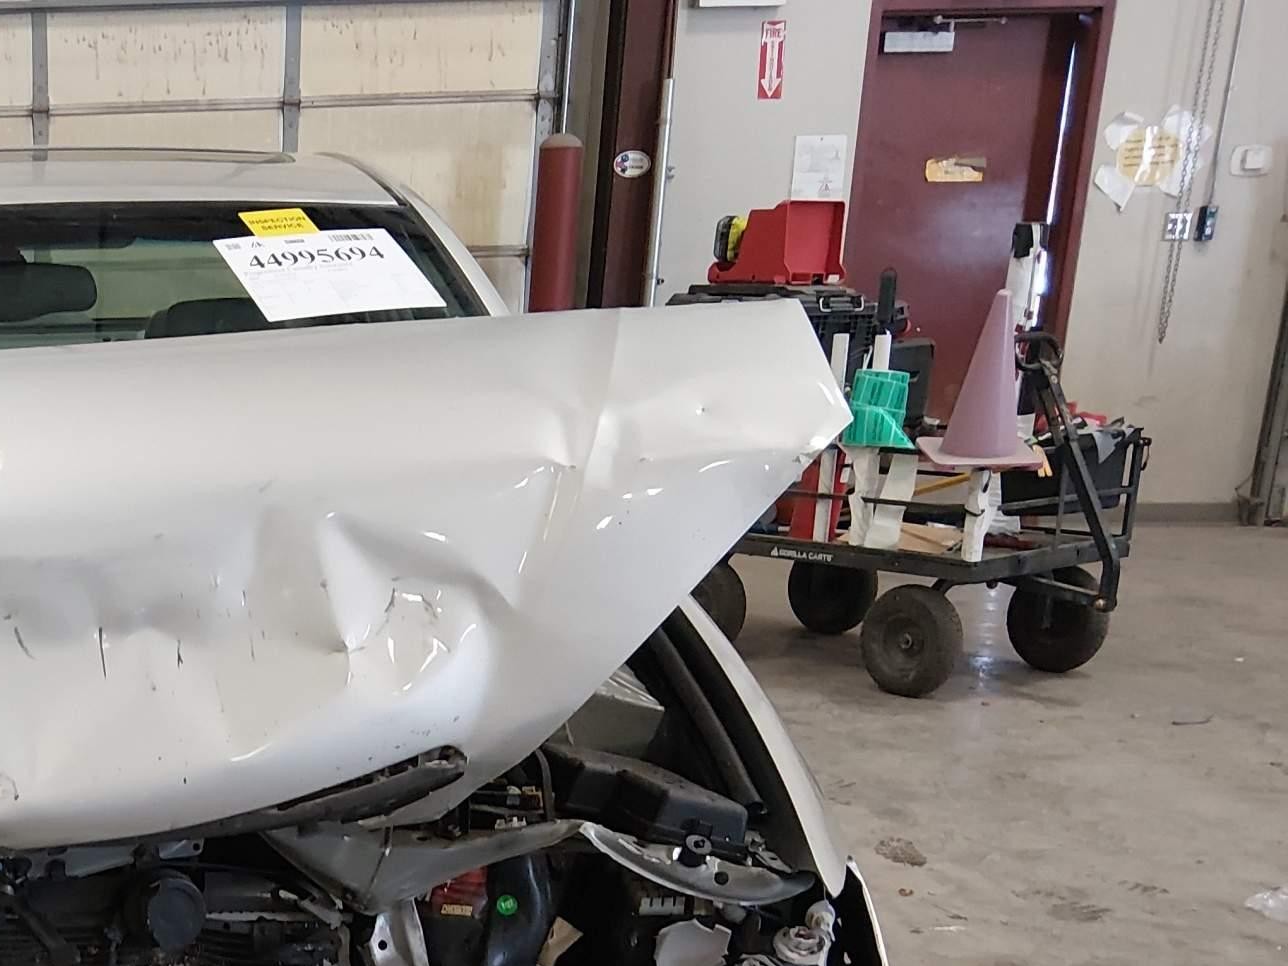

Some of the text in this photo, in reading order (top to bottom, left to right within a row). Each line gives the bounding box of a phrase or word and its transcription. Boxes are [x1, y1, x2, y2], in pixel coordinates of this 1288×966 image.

[765, 28, 782, 38] FIRE
[261, 223, 304, 231] SERVICE
[249, 245, 385, 269] 44995694
